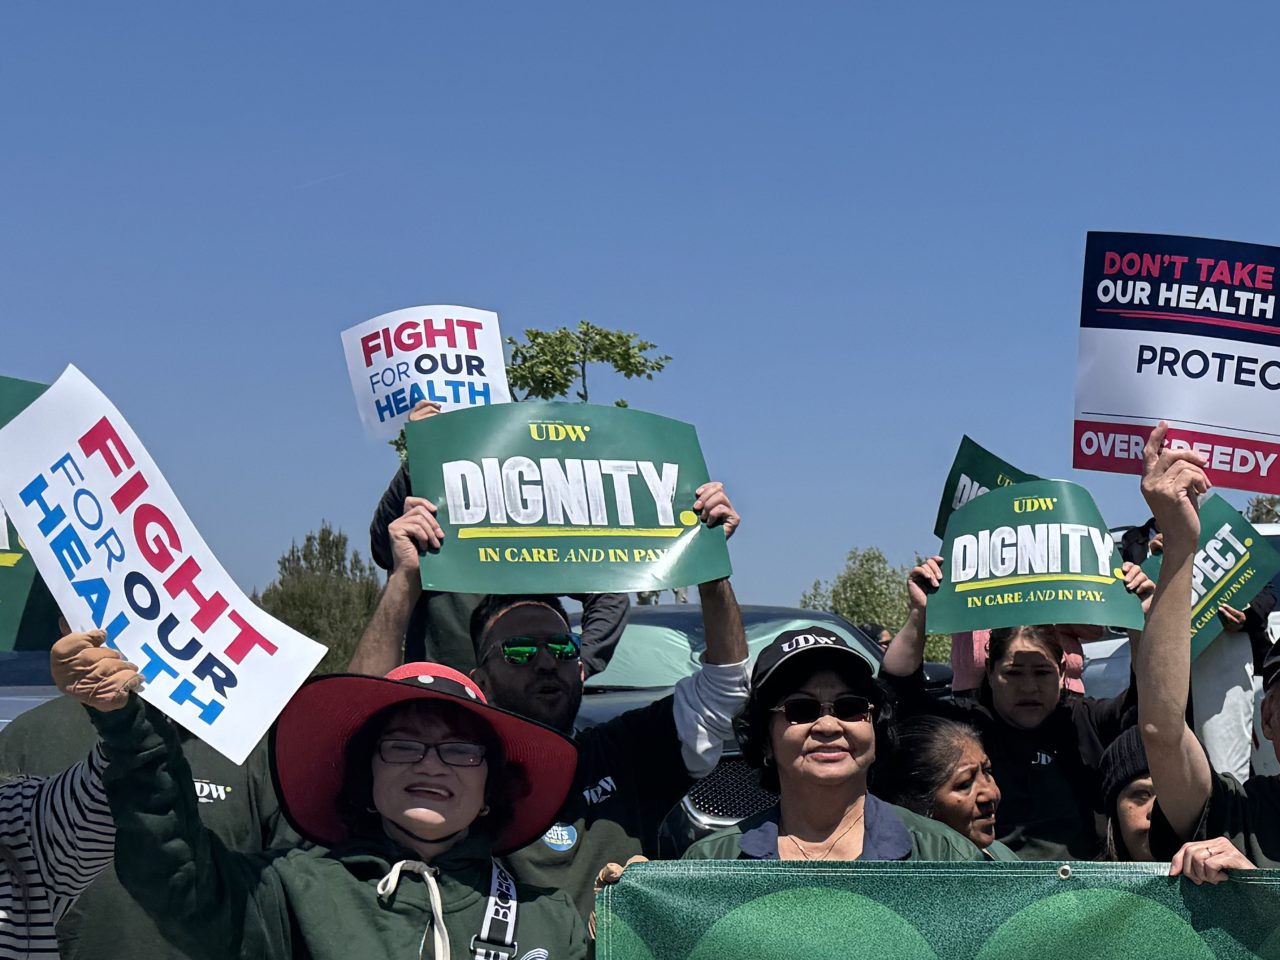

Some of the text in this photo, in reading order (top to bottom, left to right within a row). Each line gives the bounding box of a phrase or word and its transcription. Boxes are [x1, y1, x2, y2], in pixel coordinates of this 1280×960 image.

[1103, 251, 1189, 280] DON'T
[1196, 258, 1276, 291] TAKE
[1097, 279, 1151, 306] OUR
[1158, 283, 1276, 319] HEALTH
[361, 318, 483, 368] FIGHT
[370, 353, 487, 394] FOR OUR
[375, 380, 491, 423] HEALTH
[529, 423, 590, 442] UDW
[1080, 431, 1144, 460] OVER
[442, 456, 699, 527] DIGNITY.
[1013, 497, 1058, 514] UDW
[78, 416, 278, 664] FIGHT
[479, 548, 500, 562] IN
[505, 548, 560, 562] CARE
[564, 549, 604, 562] AND
[610, 549, 629, 562] IN
[951, 523, 1127, 583] DIGNITY.
[50, 452, 238, 699] FOR OUR
[19, 473, 225, 725] HEALTH
[967, 590, 1105, 608] IN CARE AND IN PAY.
[1196, 606, 1218, 630] CARE
[1230, 581, 1241, 593] IN
[194, 782, 226, 800] DW
